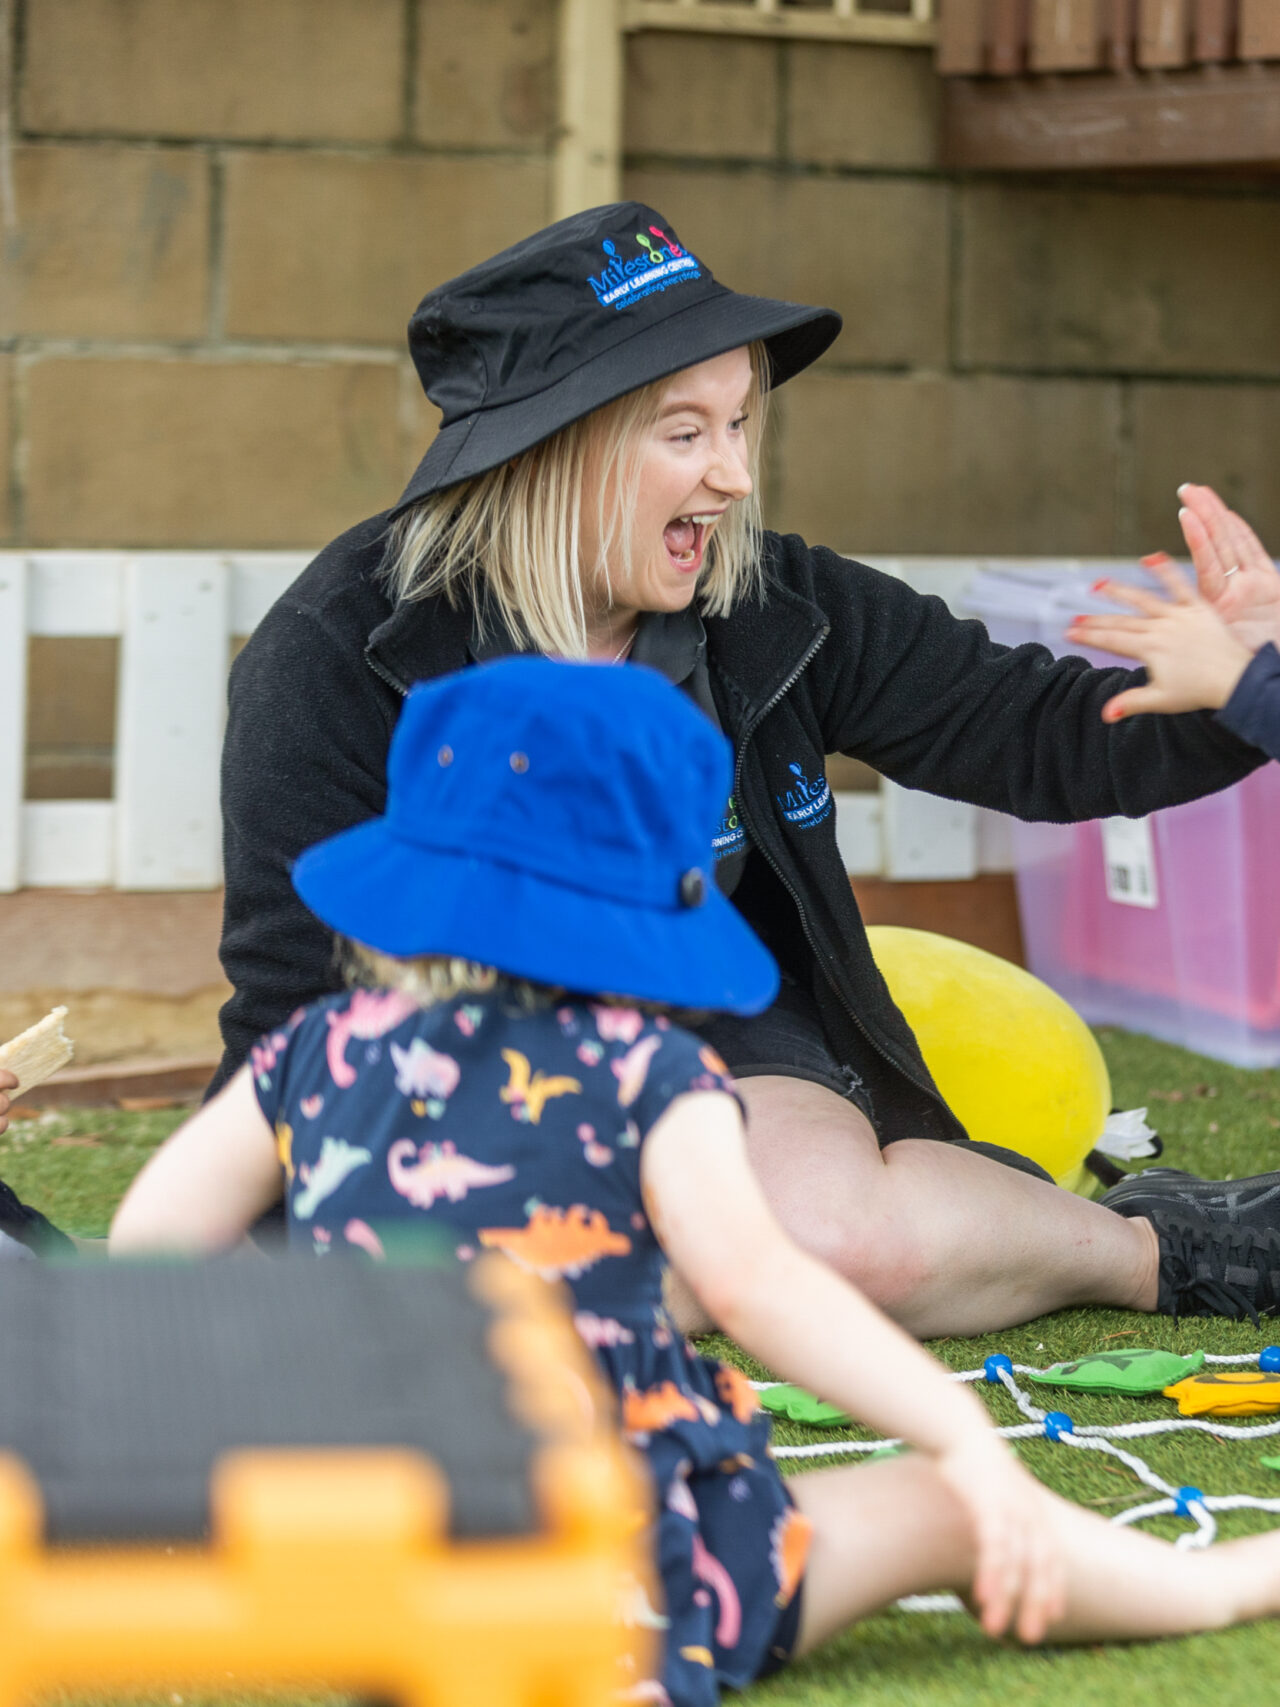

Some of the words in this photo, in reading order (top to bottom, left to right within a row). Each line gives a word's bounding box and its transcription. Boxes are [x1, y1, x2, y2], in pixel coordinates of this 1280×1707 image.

[602, 281, 631, 304] EARLY
[629, 264, 669, 289] LEARNING
[786, 804, 815, 820] EARLY
